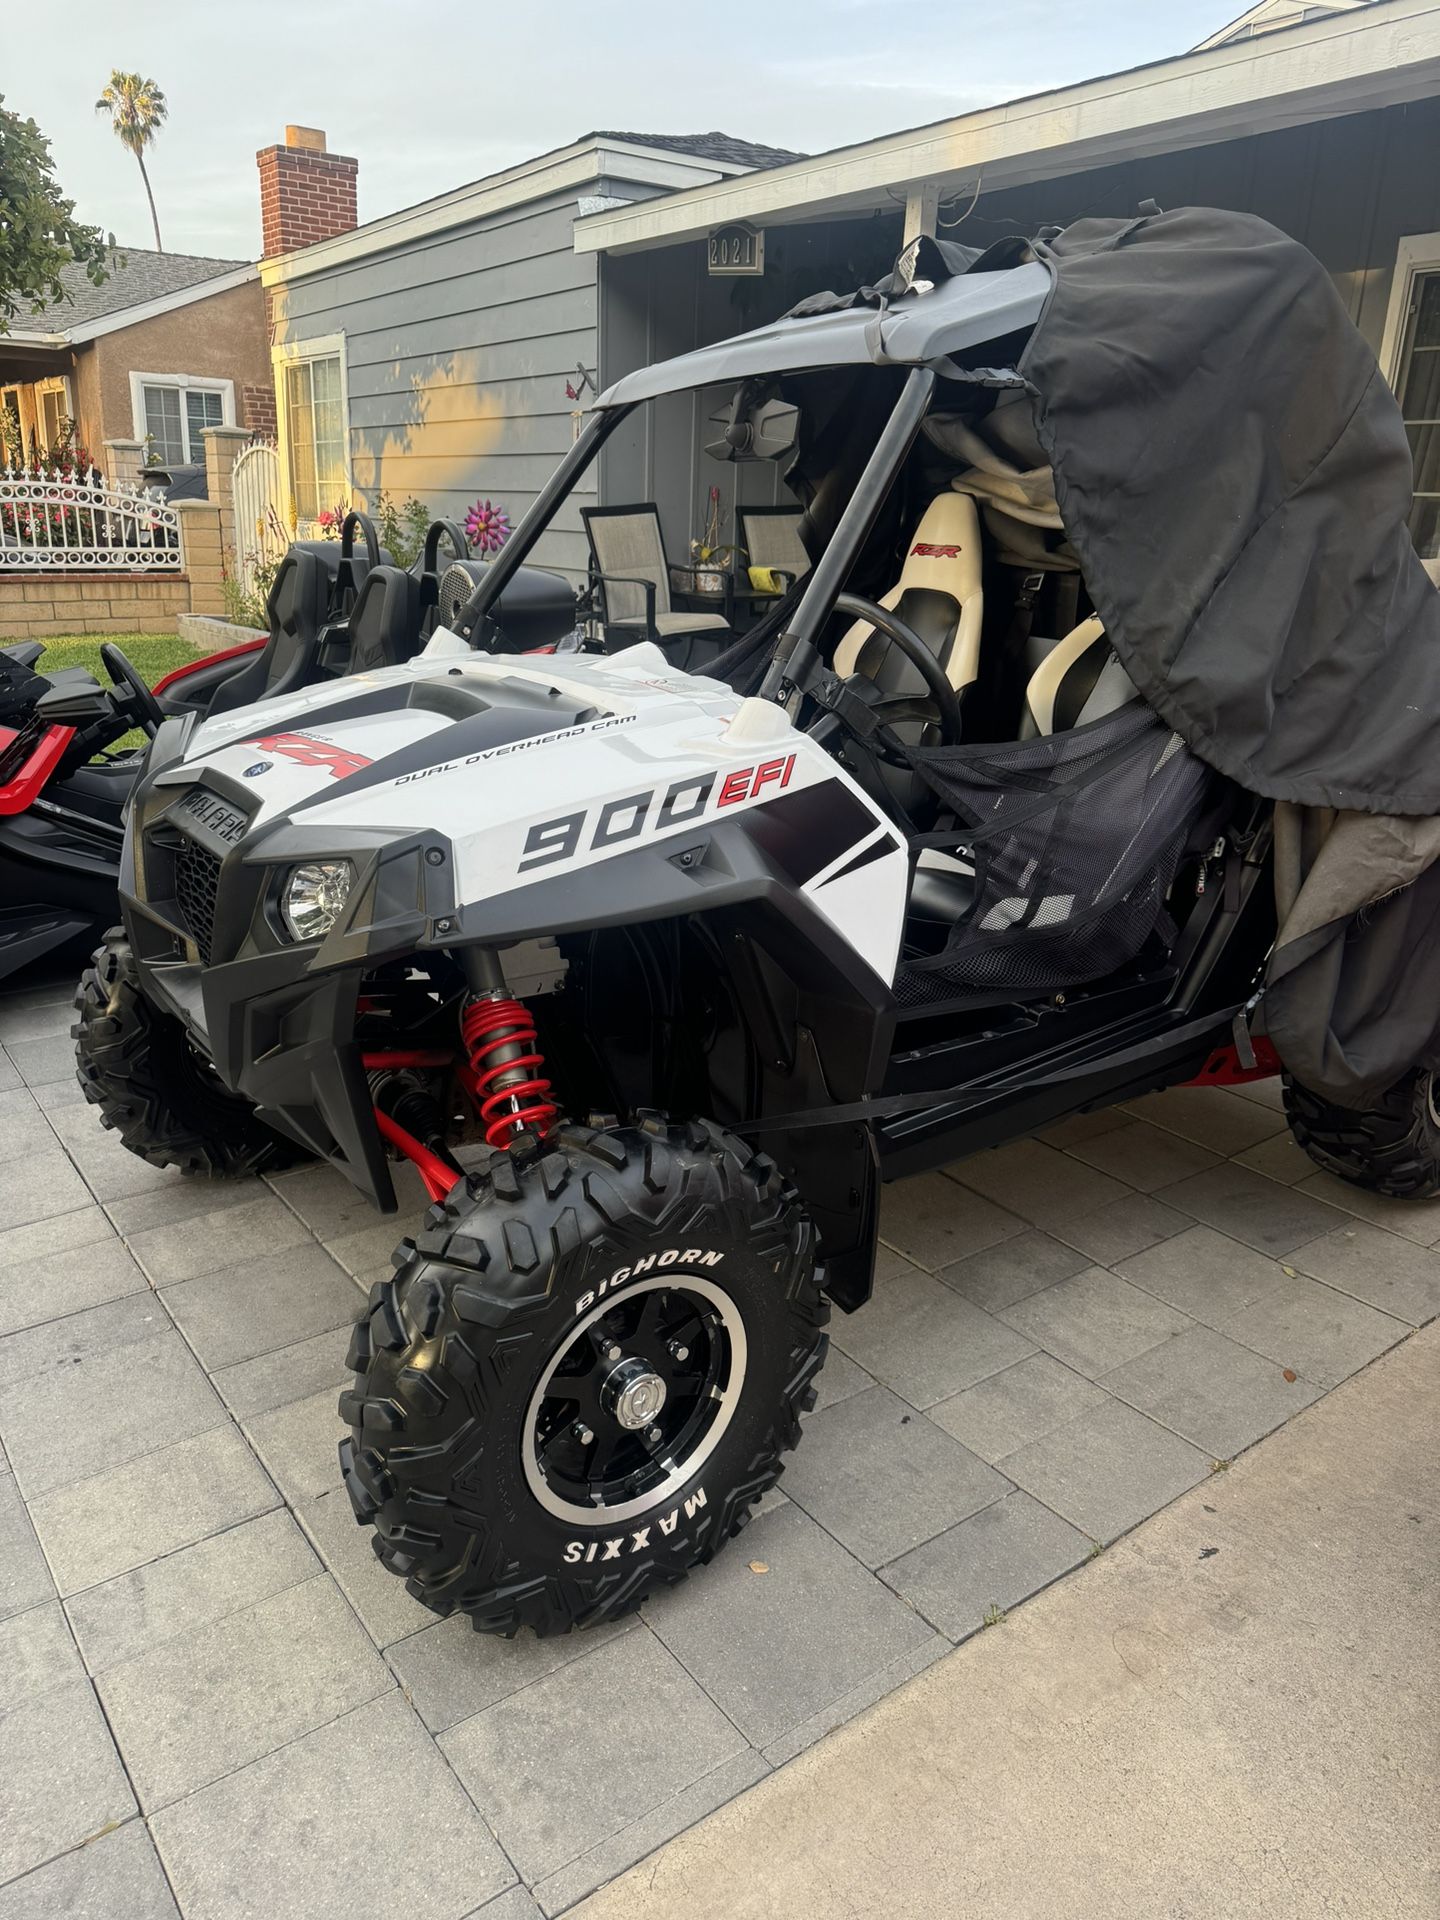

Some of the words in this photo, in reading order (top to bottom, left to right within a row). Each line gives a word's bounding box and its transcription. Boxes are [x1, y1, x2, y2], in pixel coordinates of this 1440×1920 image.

[710, 237, 750, 264] 2021
[910, 542, 962, 558] RZR
[394, 764, 458, 786] DUAL
[465, 728, 586, 765] OVERHEAD
[591, 714, 637, 731] CAM
[517, 771, 718, 874] 900
[717, 753, 798, 808] EFI
[575, 1248, 725, 1317] BIGHORN
[563, 1487, 708, 1564] MAXXIS
